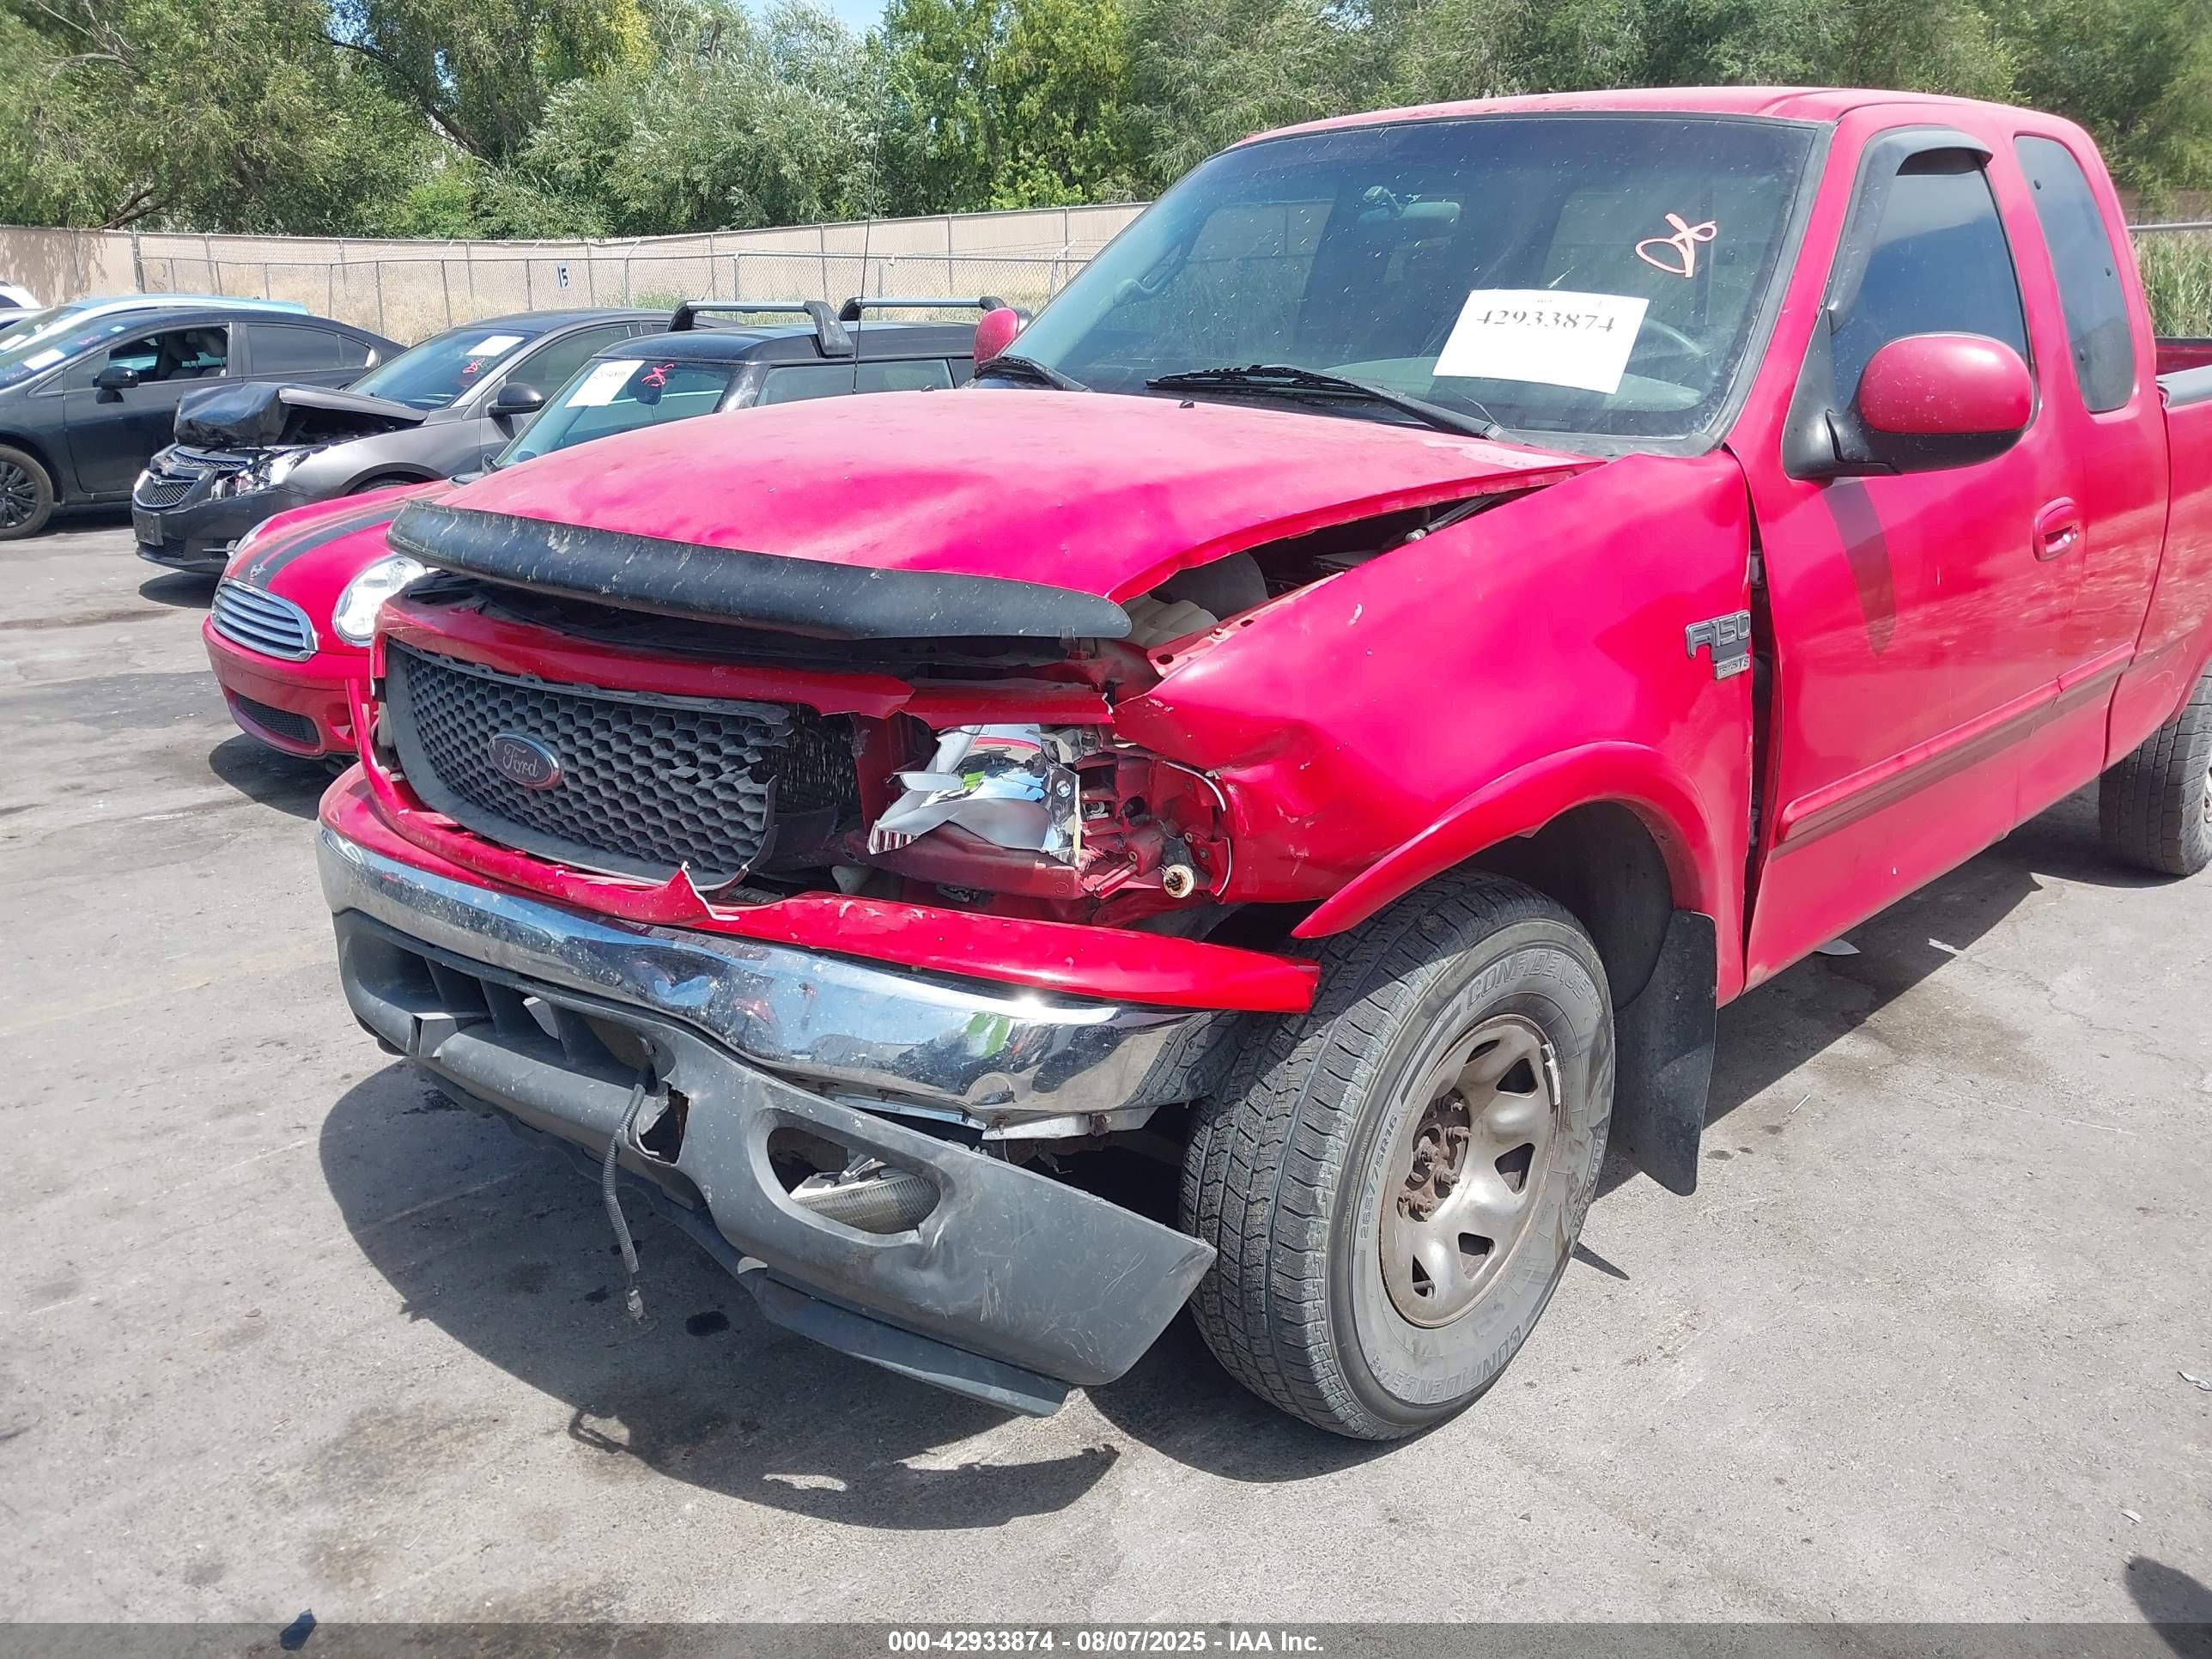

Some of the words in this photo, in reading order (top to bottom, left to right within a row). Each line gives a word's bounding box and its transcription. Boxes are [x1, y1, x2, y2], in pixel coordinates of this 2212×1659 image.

[557, 266, 568, 289] 15
[1476, 309, 1615, 333] 42933874
[502, 744, 538, 778] Ford
[1467, 948, 1590, 1010] CONFIDENCE
[1387, 1324, 1522, 1403] CONFIDENCE
